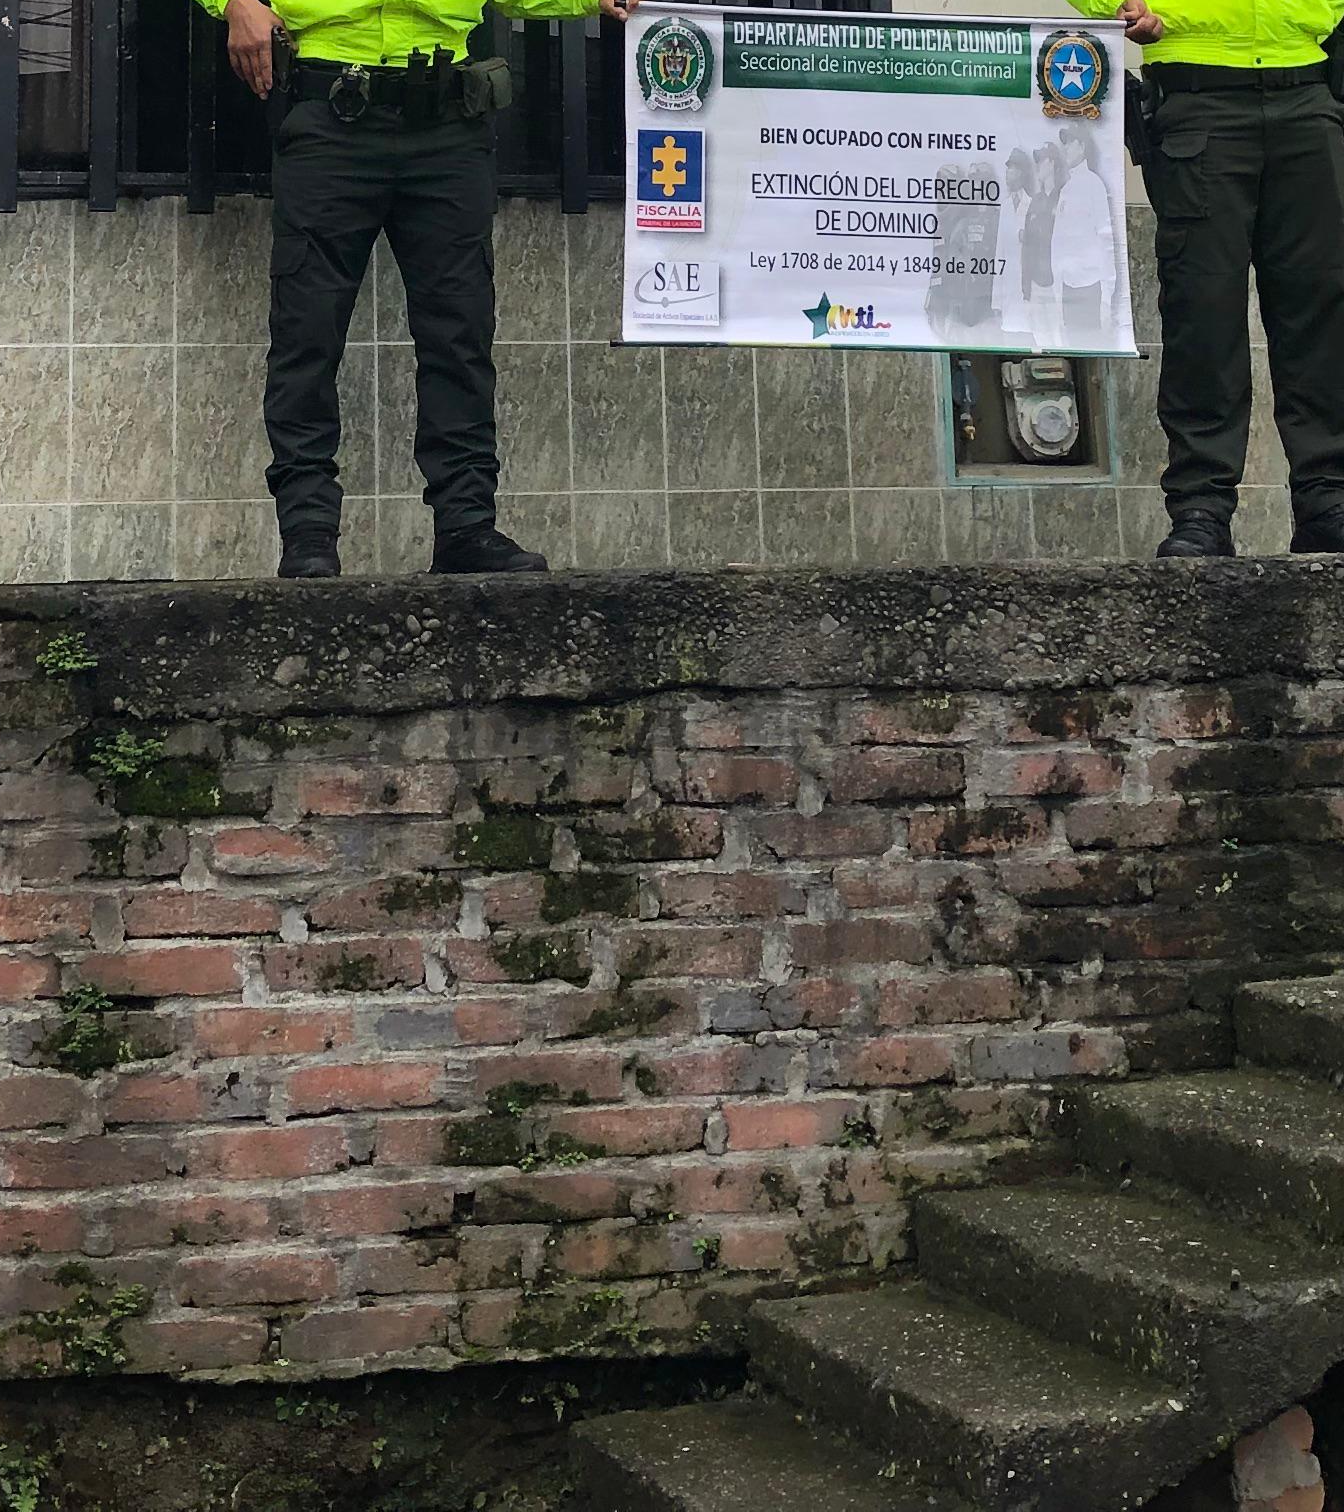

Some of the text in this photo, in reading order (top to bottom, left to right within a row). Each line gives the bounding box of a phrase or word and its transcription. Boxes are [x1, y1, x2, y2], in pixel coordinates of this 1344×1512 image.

[733, 21, 1023, 55] DEPARTAMENTO DE POLICIA QUINDÍO
[739, 51, 1017, 80] Seccional de investigación Criminal
[759, 127, 997, 152] BIEN OCUPADO CON FINES DE
[751, 171, 1001, 201] EXTINCIÓN DEL DERECHO
[636, 204, 702, 217] FISCALÍA
[815, 209, 939, 235] DE DOMINIO
[653, 261, 701, 292] SAE
[750, 251, 1007, 276] Ley 1708 de 2014 y 1849 de 2017
